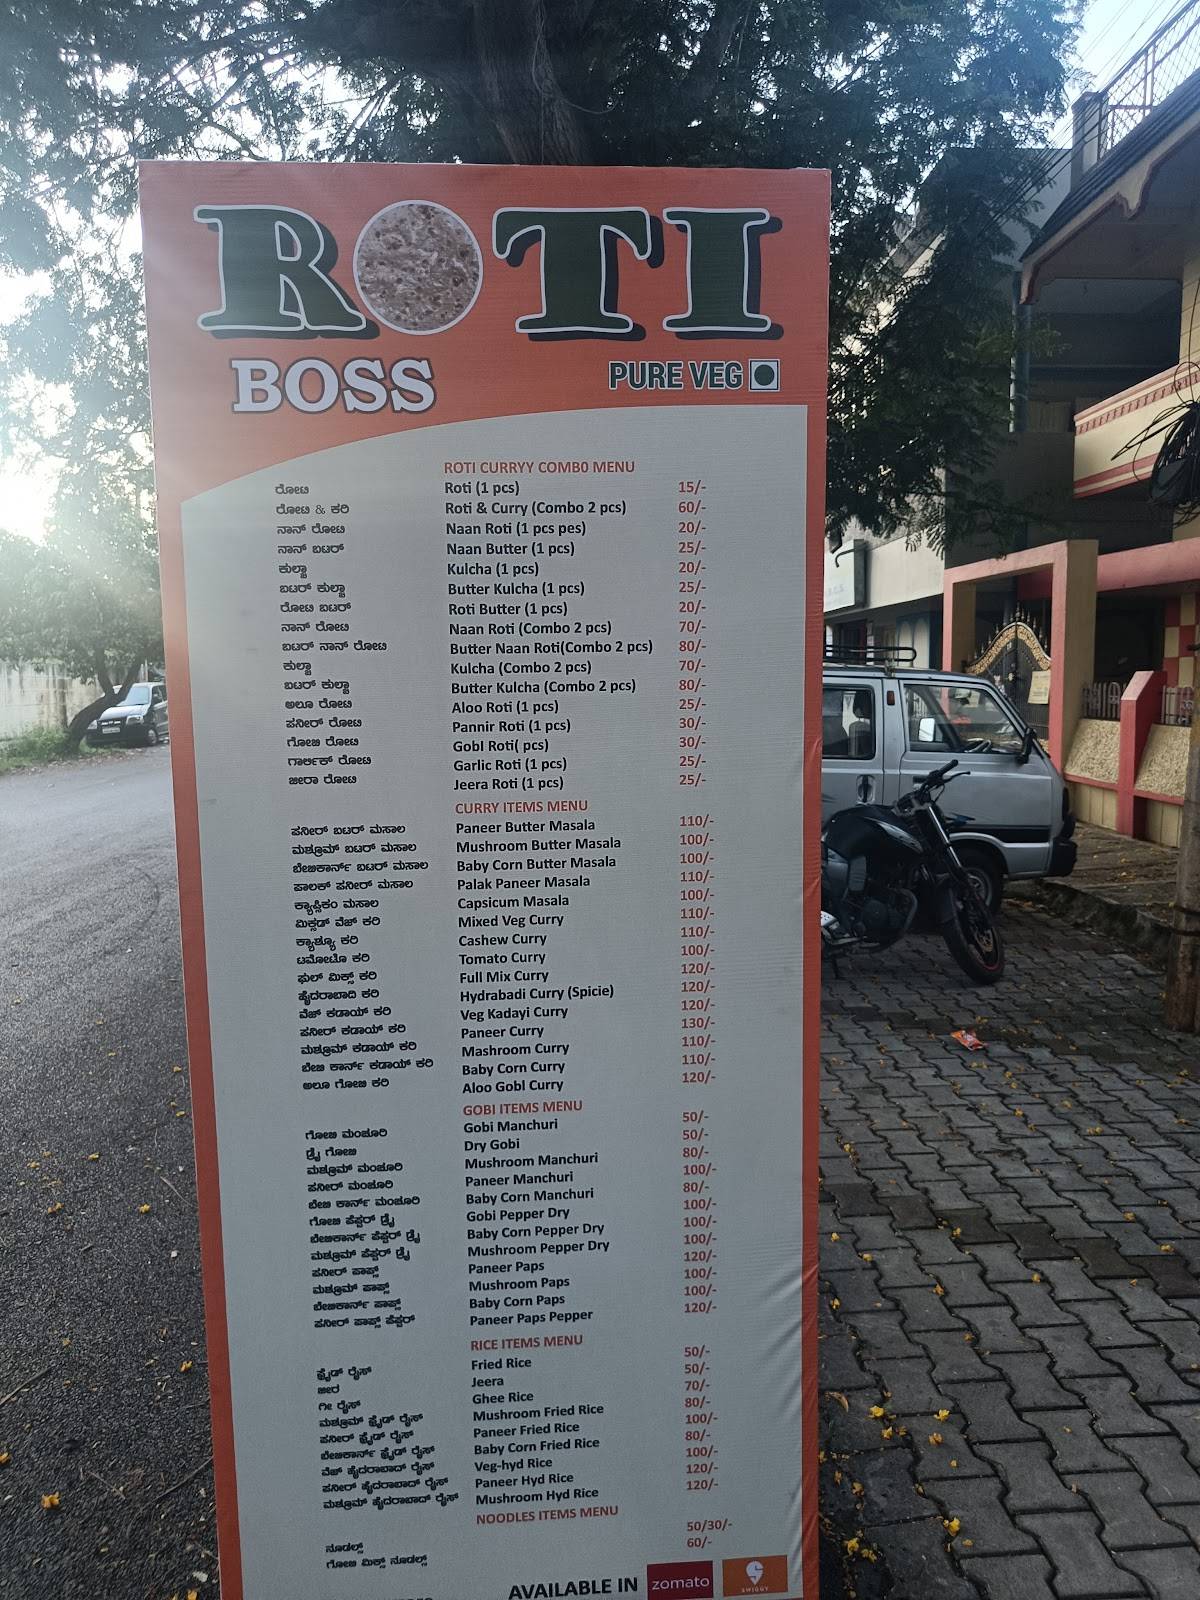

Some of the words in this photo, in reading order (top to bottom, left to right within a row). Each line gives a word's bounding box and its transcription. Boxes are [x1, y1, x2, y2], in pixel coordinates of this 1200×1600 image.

[609, 360, 682, 391] PURE
[688, 360, 743, 390] VEG
[230, 356, 437, 414] BOSS
[444, 461, 476, 474] ROTI
[479, 461, 535, 474] CURRYY
[592, 460, 635, 474] MENU
[444, 481, 472, 494] Roti
[678, 479, 707, 496] 15/-
[314, 504, 326, 515] &
[445, 501, 473, 515] Roti
[475, 501, 488, 515] &
[491, 501, 529, 517] Curry
[587, 501, 597, 514] 2
[678, 499, 707, 516] 60/-
[678, 519, 707, 536] 20/-
[447, 562, 492, 576] Kulcha
[678, 559, 707, 576] 20/-
[447, 583, 491, 596] Butter
[493, 581, 539, 595] Kulcha
[678, 579, 707, 596] 25/-
[678, 619, 707, 635] 70/-
[678, 638, 707, 655] 80/-
[450, 661, 495, 675] Kulcha
[553, 661, 563, 673] 2
[678, 657, 707, 674] 70/-
[451, 700, 483, 714] Aloo
[486, 700, 513, 713] Roti
[679, 696, 707, 712] 25/-
[679, 734, 707, 750] 30/-
[679, 753, 707, 769] 25/-
[455, 801, 500, 815] CURRY
[503, 801, 544, 814] ITEMS
[547, 799, 588, 813] MENU
[455, 822, 503, 835] Paneer
[505, 821, 546, 833] Butter
[549, 818, 596, 832] Masala
[679, 813, 715, 829] 110/-
[456, 840, 528, 854] Mushroom
[531, 839, 573, 851] Butter
[575, 836, 622, 850] Masala
[679, 832, 715, 848] 100/-
[457, 877, 493, 891] Palak
[495, 878, 542, 890] Paneer
[544, 874, 591, 888] Masala
[680, 869, 715, 884] 110/-
[457, 896, 520, 912] Capsicum
[522, 893, 570, 908] Masala
[680, 887, 715, 903] 100/-
[680, 905, 715, 921] 110/-
[458, 914, 499, 928] Mixed
[501, 914, 527, 929] Veg
[528, 914, 565, 927] Curry
[680, 942, 716, 958] 100/-
[681, 978, 716, 994] 120/-
[460, 987, 527, 1005] Hydrabadi
[529, 987, 565, 1001] Curry
[681, 997, 716, 1013] 120/-
[459, 1009, 485, 1023] Veg
[487, 1006, 531, 1021] Kadayi
[533, 1006, 569, 1020] Curry
[681, 1015, 716, 1031] 130/-
[681, 1051, 716, 1067] 110/-
[462, 1103, 496, 1116] GOBI
[499, 1102, 540, 1115] ITEMS
[542, 1099, 583, 1113] MENU
[682, 1109, 710, 1125] 50/-
[463, 1120, 494, 1134] Gobi
[497, 1117, 559, 1133] Manchuri
[682, 1127, 709, 1142] 50/-
[463, 1140, 488, 1154] Dry
[489, 1137, 521, 1151] Gobi
[682, 1145, 710, 1160] 80/-
[464, 1156, 535, 1170] Mushroom
[537, 1151, 599, 1167] Manchuri
[682, 1179, 710, 1195] 80/-
[683, 1196, 717, 1212] 100/-
[466, 1209, 497, 1223] Gobi
[499, 1209, 545, 1223] Pepper
[547, 1207, 571, 1221] Dry
[683, 1231, 718, 1247] 100/-
[467, 1244, 537, 1258] Mushroom
[540, 1242, 585, 1256] Pepper
[587, 1239, 610, 1253] Dry
[683, 1248, 718, 1264] 120/-
[683, 1283, 717, 1298] 100/-
[470, 1339, 499, 1352] RICE
[501, 1336, 541, 1350] ITEMS
[543, 1334, 583, 1348] MENU
[683, 1343, 711, 1360] 50/-
[471, 1357, 503, 1371] Fried
[505, 1356, 533, 1369] Rice
[684, 1361, 711, 1376] 50/-
[470, 1376, 505, 1388] Jeera
[684, 1378, 711, 1393] 70/-
[471, 1392, 506, 1405] Ghee
[508, 1391, 535, 1403] Rice
[685, 1411, 719, 1425] 100/-
[473, 1427, 518, 1439] Paneer
[519, 1422, 552, 1436] Fried
[553, 1421, 581, 1434] Rice
[685, 1444, 719, 1459] 100/-
[527, 1457, 553, 1469] Rice
[685, 1461, 719, 1475] 120/-
[474, 1477, 519, 1489] Paneer
[521, 1473, 546, 1488] Hyd
[548, 1472, 575, 1485] Rice
[686, 1477, 719, 1492] 120/-
[476, 1510, 536, 1525] NOODLES
[538, 1507, 577, 1521] ITEMS
[579, 1504, 619, 1519] MENU
[686, 1517, 733, 1534] 50/30/-
[687, 1536, 713, 1549] 60/-
[508, 1579, 612, 1600] AVAILABLE
[617, 1576, 639, 1594] IN
[652, 1576, 710, 1591] zomato
